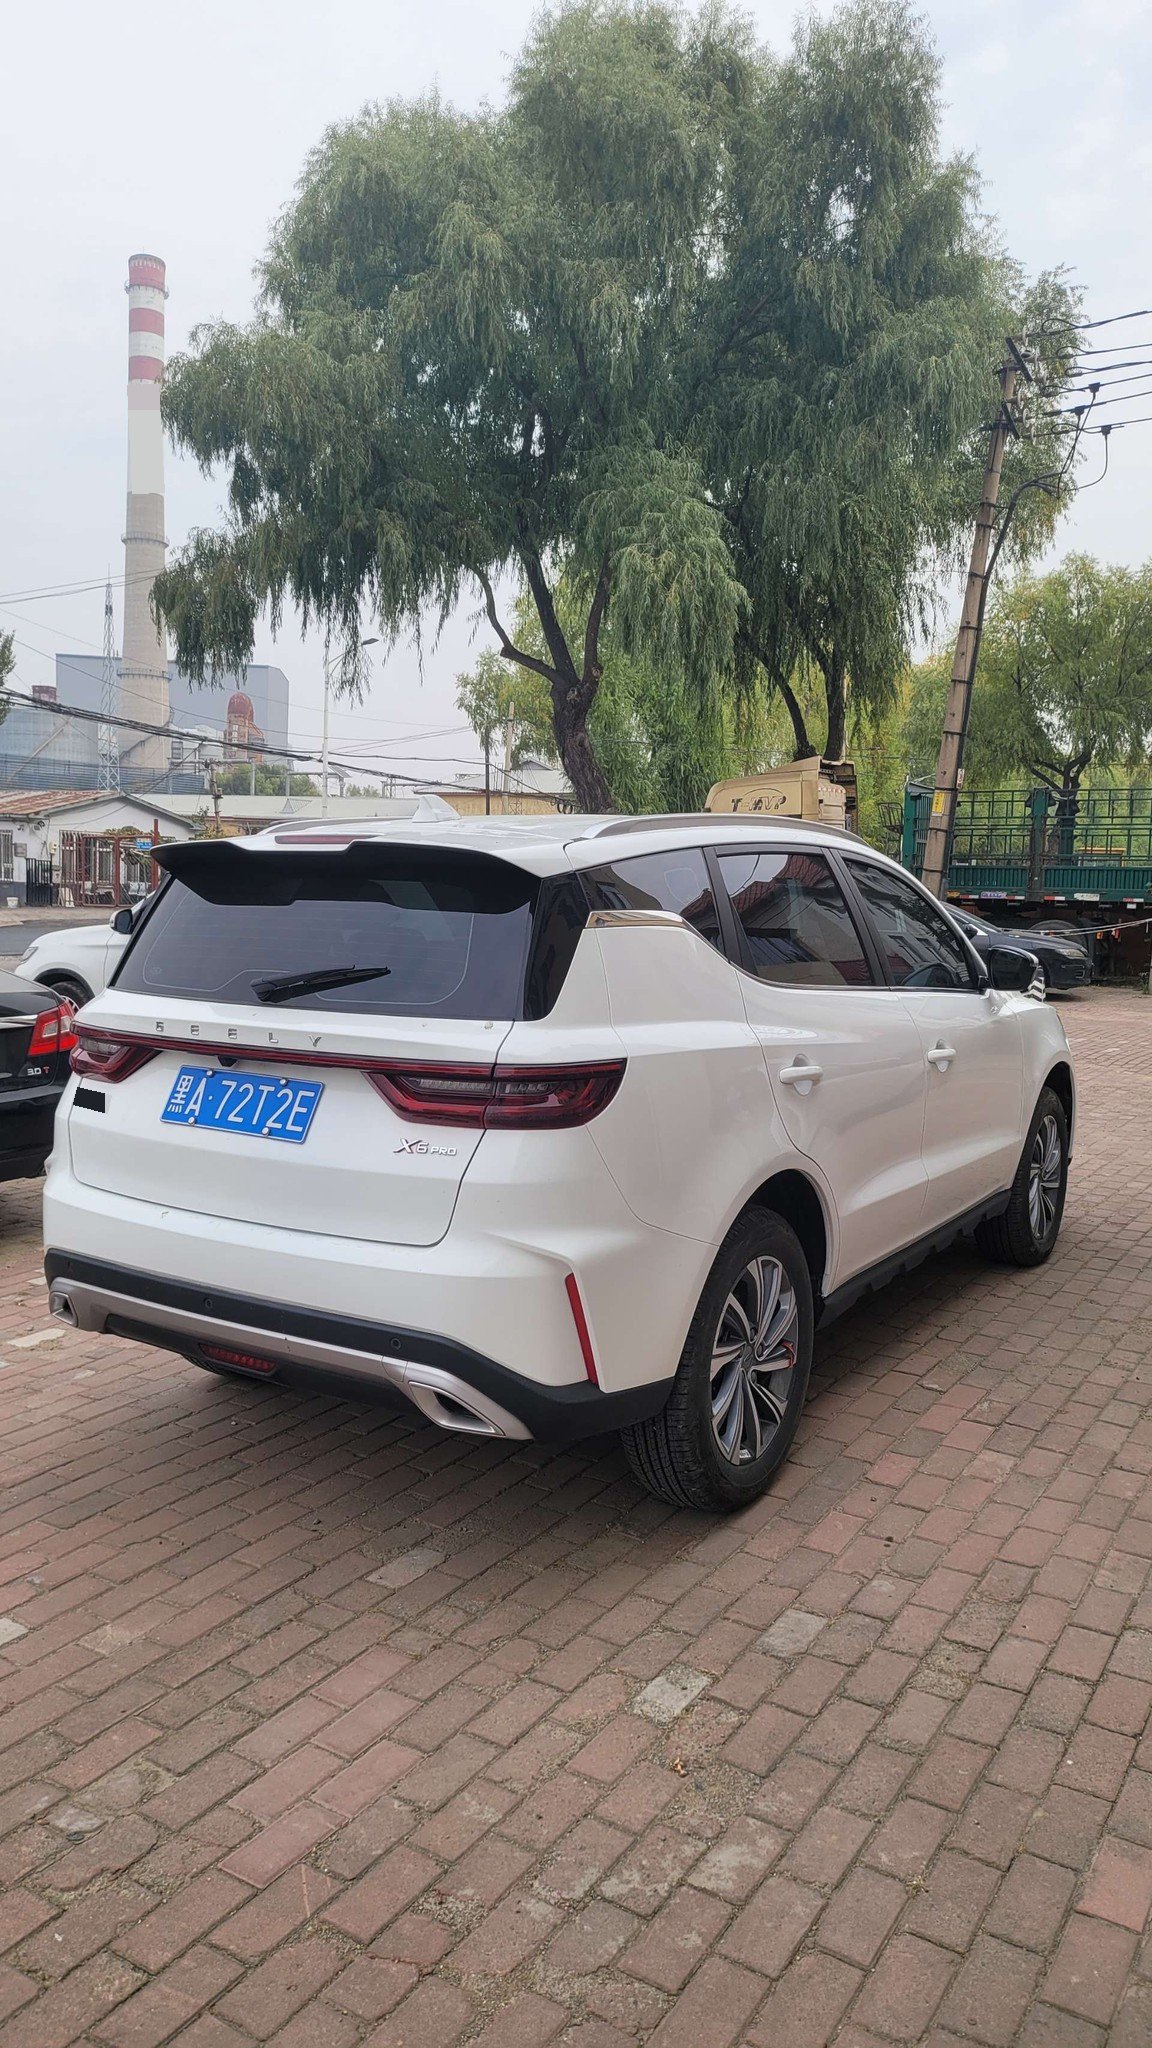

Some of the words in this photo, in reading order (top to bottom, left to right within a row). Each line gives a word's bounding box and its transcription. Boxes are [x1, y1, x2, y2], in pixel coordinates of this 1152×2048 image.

[155, 1021, 322, 1047] GEELY
[393, 1138, 429, 1154] X6
[430, 1146, 457, 1156] PRO
